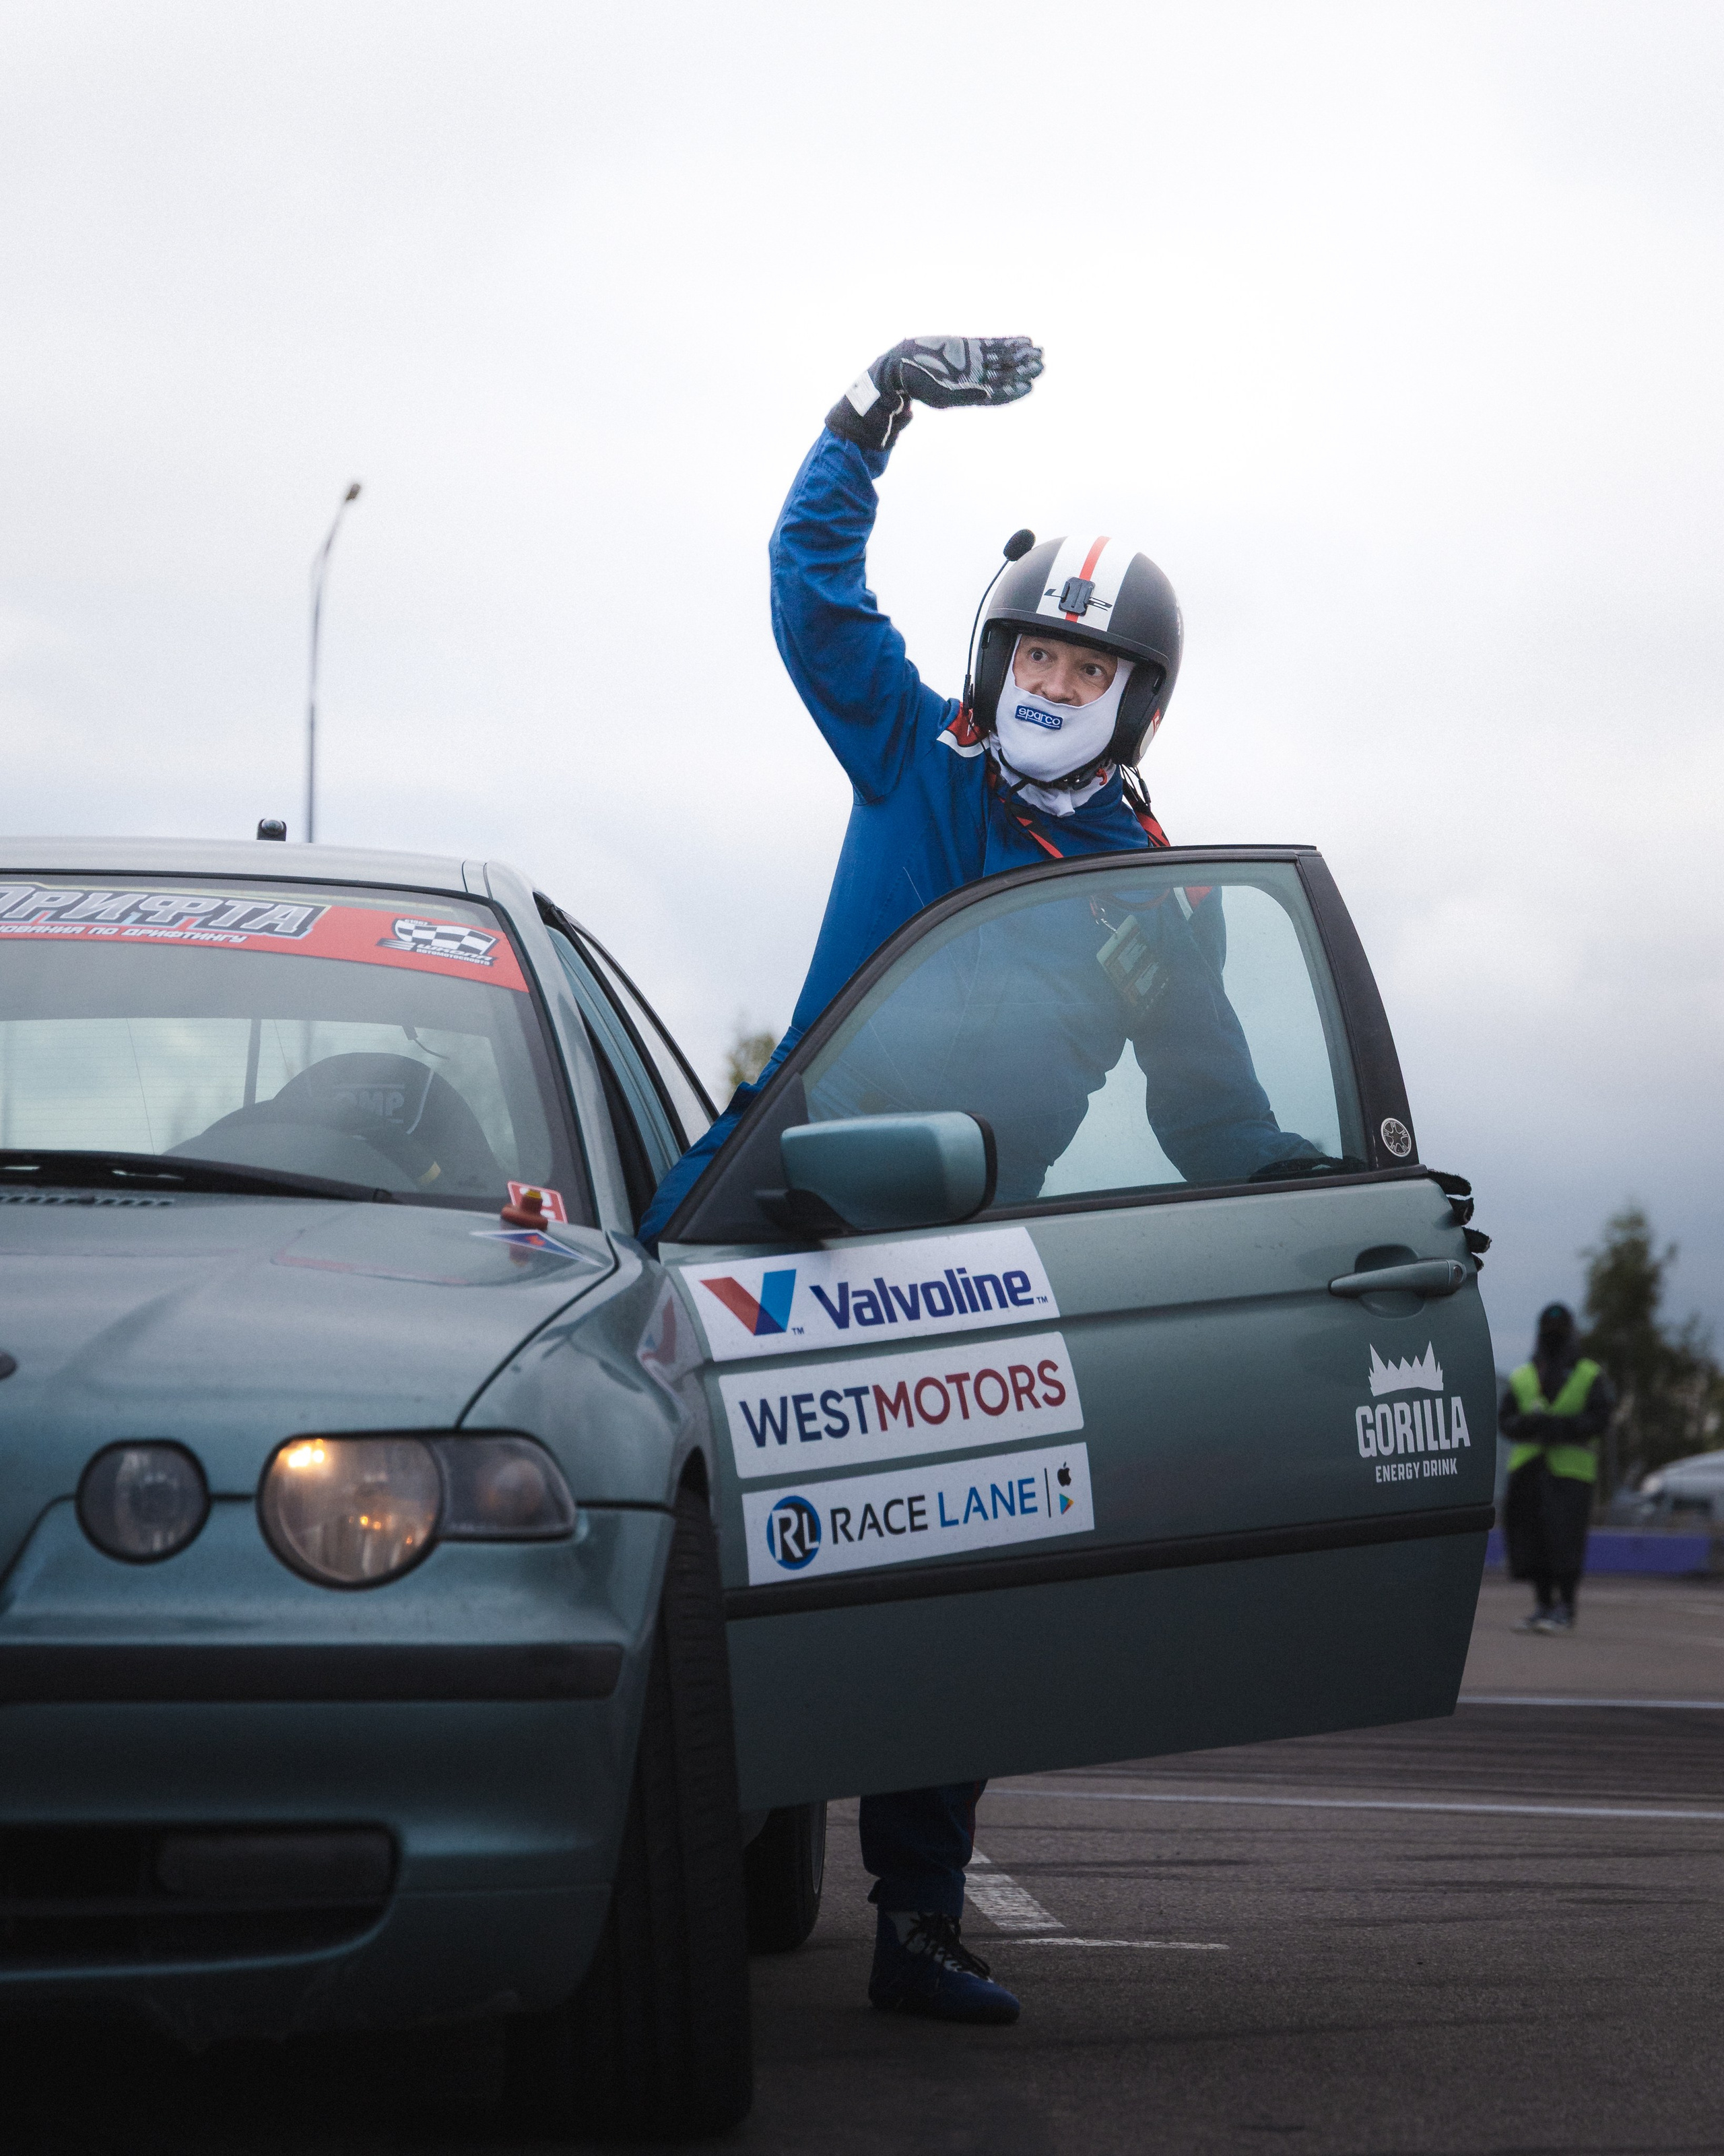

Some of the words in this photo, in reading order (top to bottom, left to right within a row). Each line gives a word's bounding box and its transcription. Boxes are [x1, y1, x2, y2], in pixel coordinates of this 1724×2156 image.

[1018, 707, 1061, 725] sparco
[88, 927, 119, 935] ПО
[121, 928, 247, 943] ДРИФТИНГУ
[809, 1267, 1034, 1330] Valvoline
[1355, 1396, 1471, 1458] GORILLA
[1375, 1462, 1420, 1482] ENERGY
[1423, 1458, 1458, 1478] DRINK
[830, 1495, 928, 1545] RACE
[937, 1478, 1038, 1528] LANE
